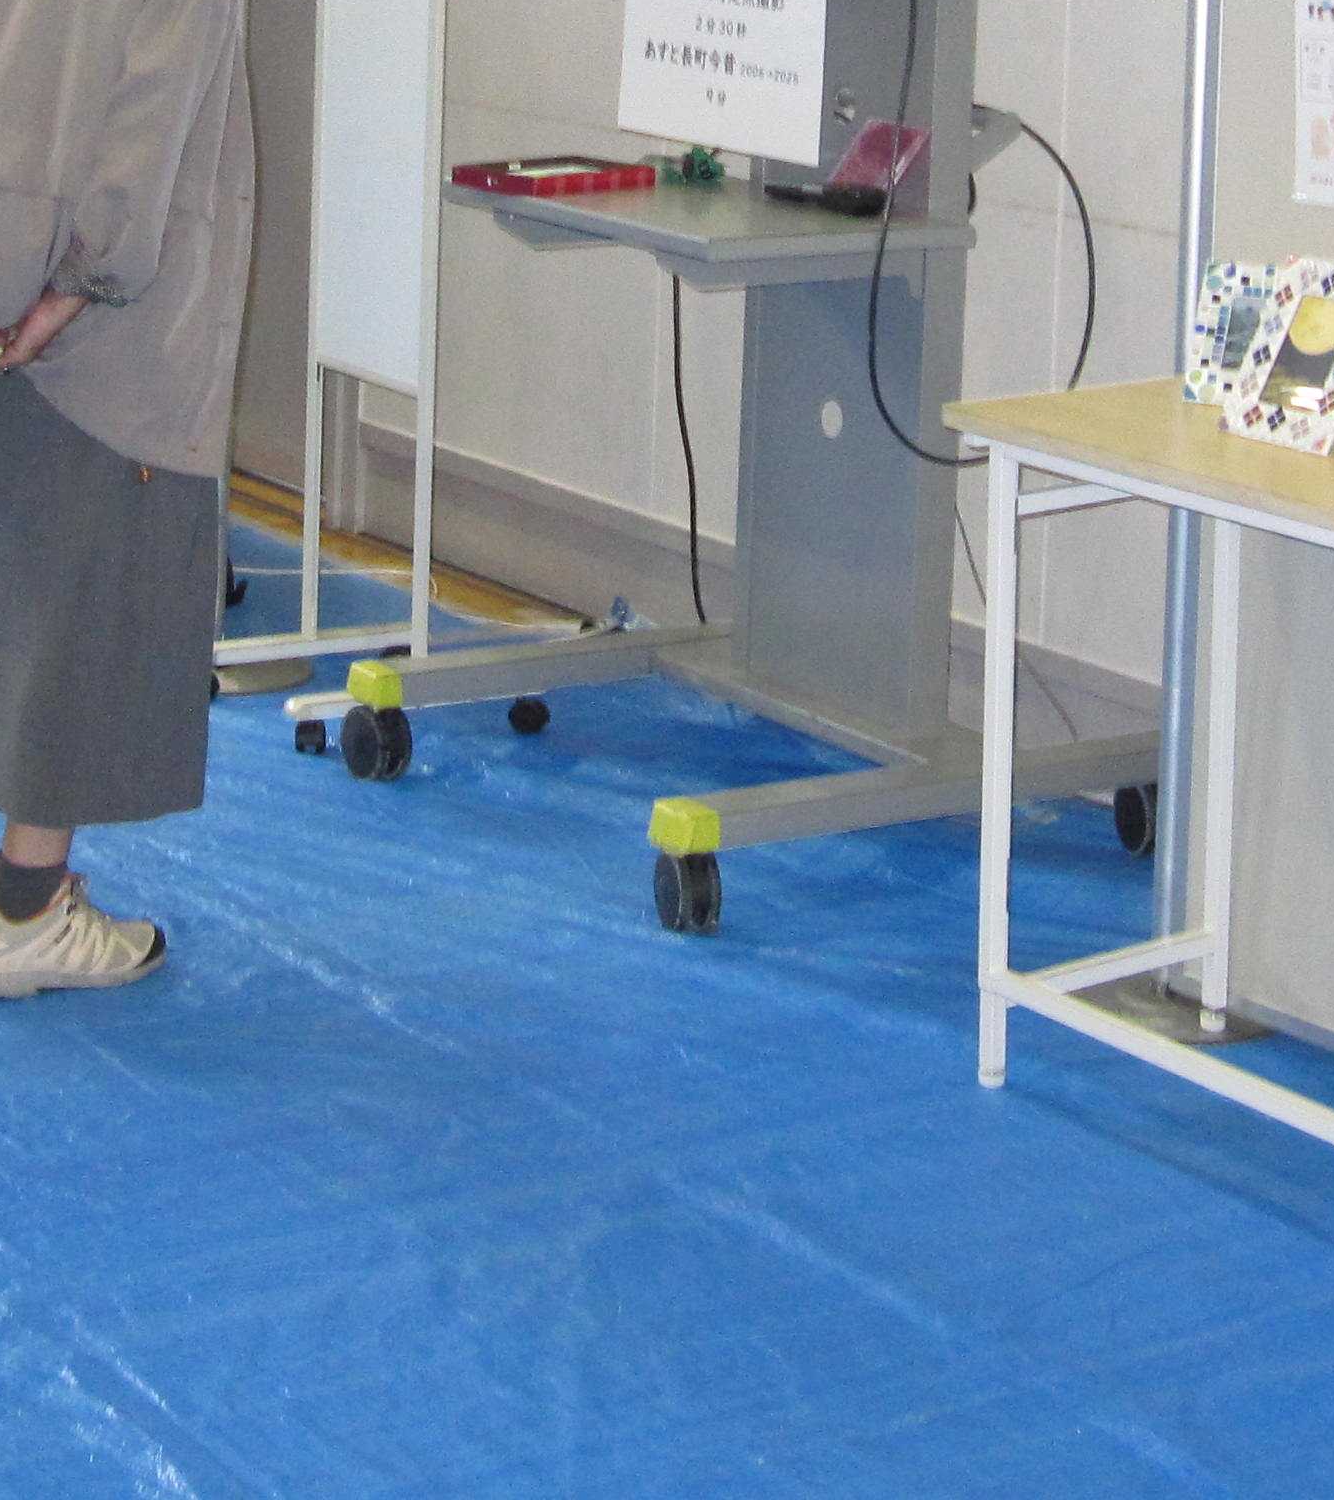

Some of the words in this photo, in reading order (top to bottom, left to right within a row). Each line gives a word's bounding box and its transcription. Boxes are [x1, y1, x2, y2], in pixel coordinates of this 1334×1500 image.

[644, 38, 737, 76] あすと長町今昔
